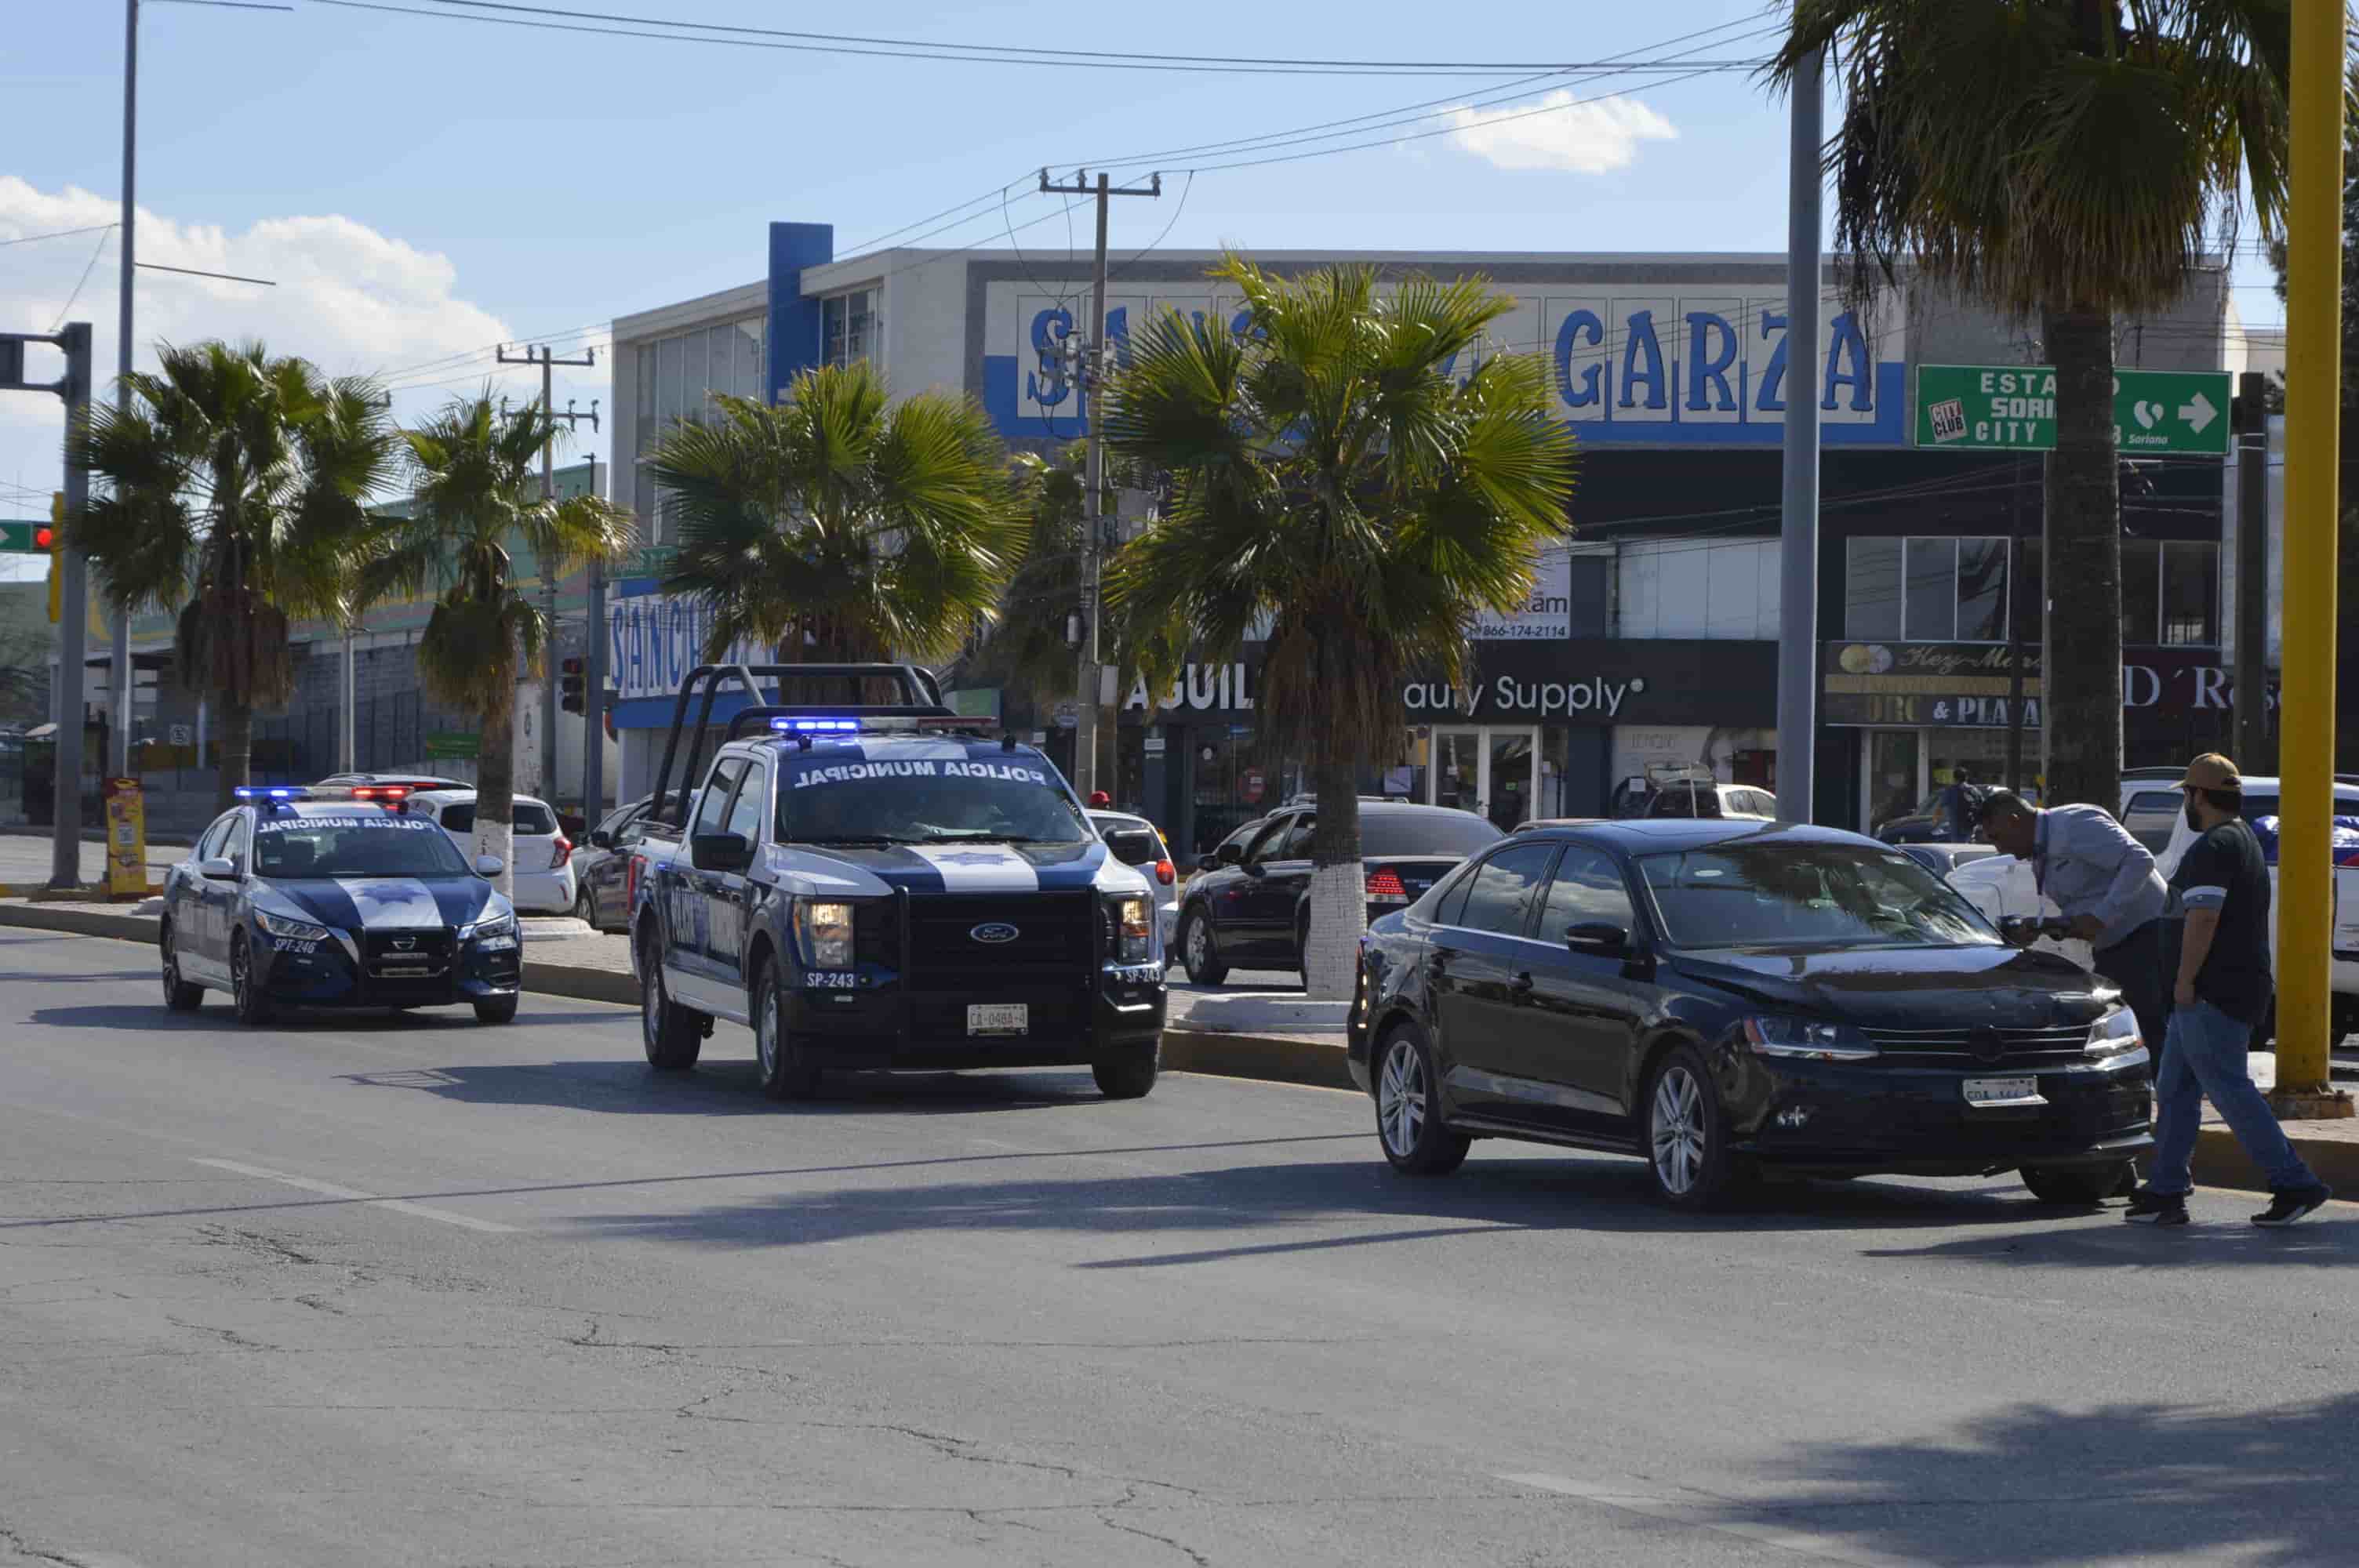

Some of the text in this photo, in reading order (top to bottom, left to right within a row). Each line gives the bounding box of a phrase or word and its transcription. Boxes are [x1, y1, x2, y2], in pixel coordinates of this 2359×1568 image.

[1555, 309, 1874, 411] GARZA
[1932, 401, 1960, 423] CITY
[1990, 397, 2056, 419] SORI
[1934, 416, 1964, 437] CLUB
[1976, 421, 2037, 443] CITY
[2128, 434, 2168, 445] Soriana
[1496, 675, 1626, 717] Supply
[1932, 701, 1951, 720] &
[1957, 697, 2041, 725] PLAA
[806, 972, 855, 989] SP-243
